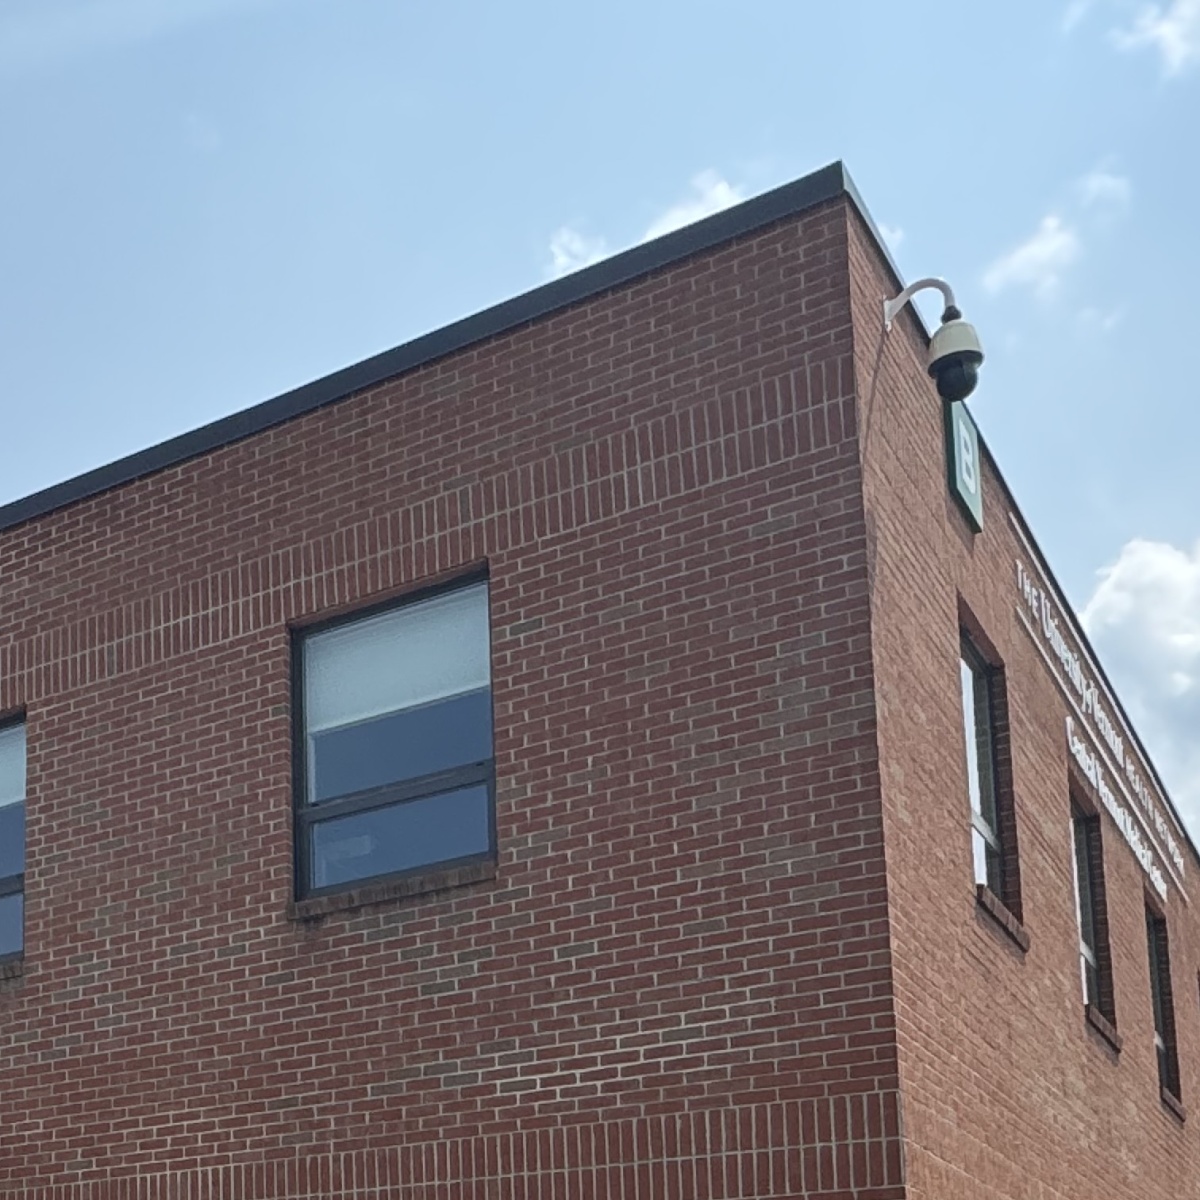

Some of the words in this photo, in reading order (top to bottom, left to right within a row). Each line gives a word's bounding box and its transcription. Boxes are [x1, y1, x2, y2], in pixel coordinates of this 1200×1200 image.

[959, 418, 976, 494] B
[1016, 559, 1039, 619] THE
[1039, 588, 1086, 713] University
[1090, 680, 1125, 768] Vermont
